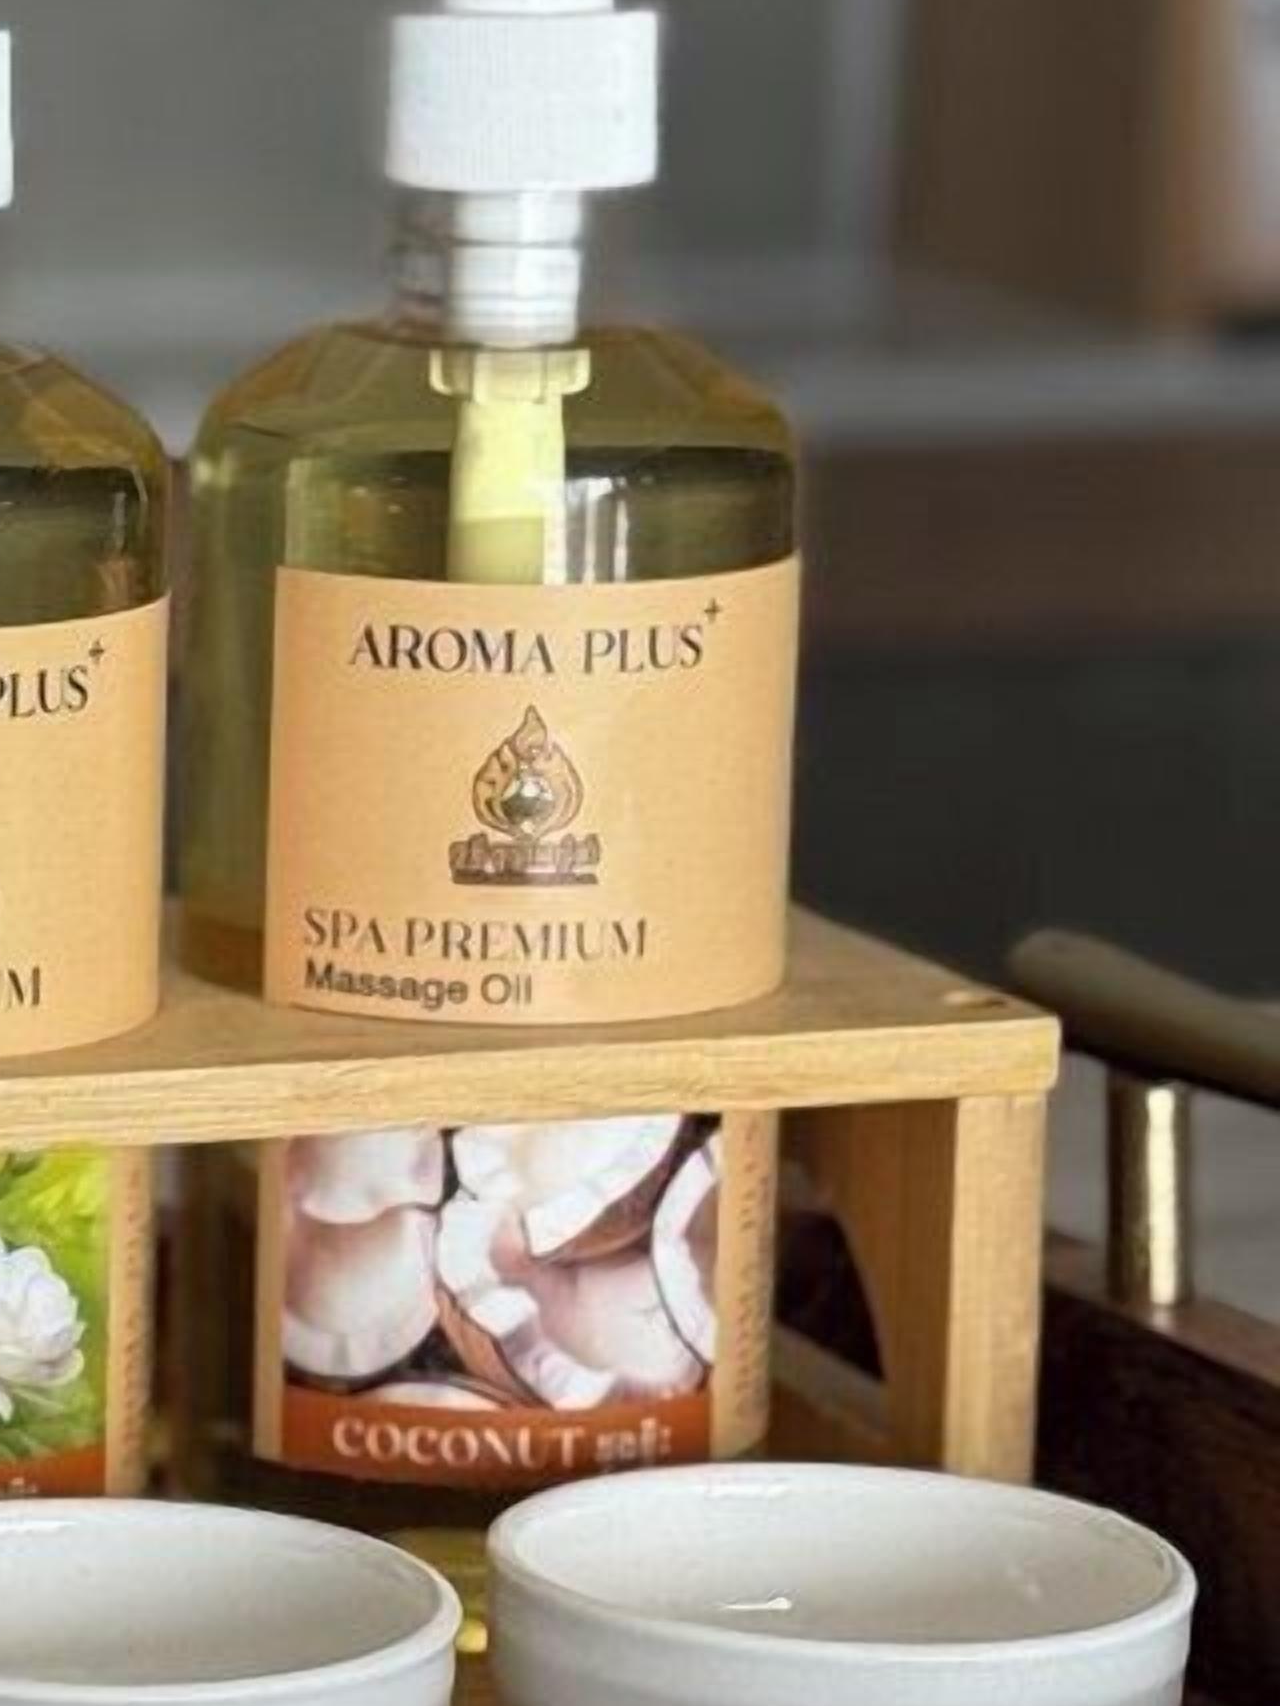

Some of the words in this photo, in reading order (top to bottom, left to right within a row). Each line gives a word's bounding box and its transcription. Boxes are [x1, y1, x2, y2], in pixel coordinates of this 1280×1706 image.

[350, 623, 556, 674] AROMA
[303, 909, 385, 955] SPA
[406, 916, 648, 962] PREMIUM
[303, 957, 469, 1008] Massage
[481, 972, 532, 1006] Oil
[332, 1416, 586, 1469] COCONUT
